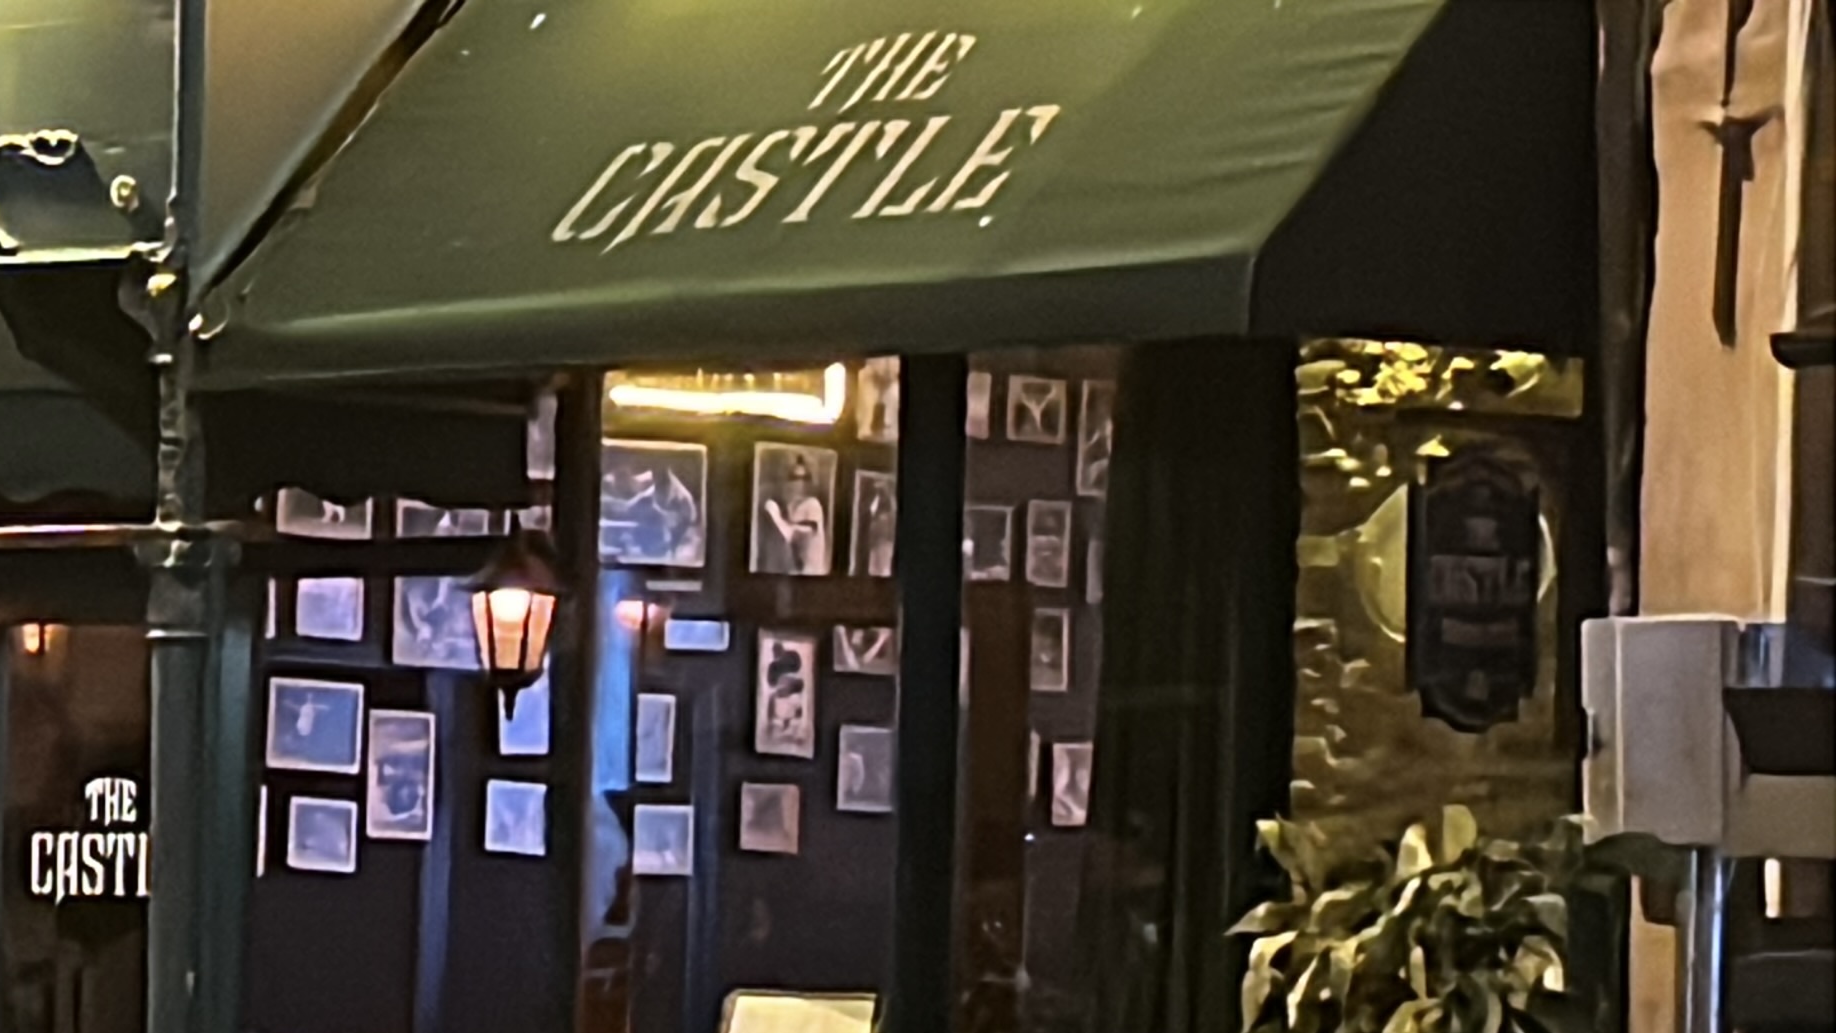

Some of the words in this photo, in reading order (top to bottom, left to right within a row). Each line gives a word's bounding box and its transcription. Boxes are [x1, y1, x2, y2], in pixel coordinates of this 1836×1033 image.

[807, 30, 977, 114] THE
[552, 104, 1061, 256] CASTLE
[84, 776, 138, 827] THE
[30, 830, 152, 906] CASTL
